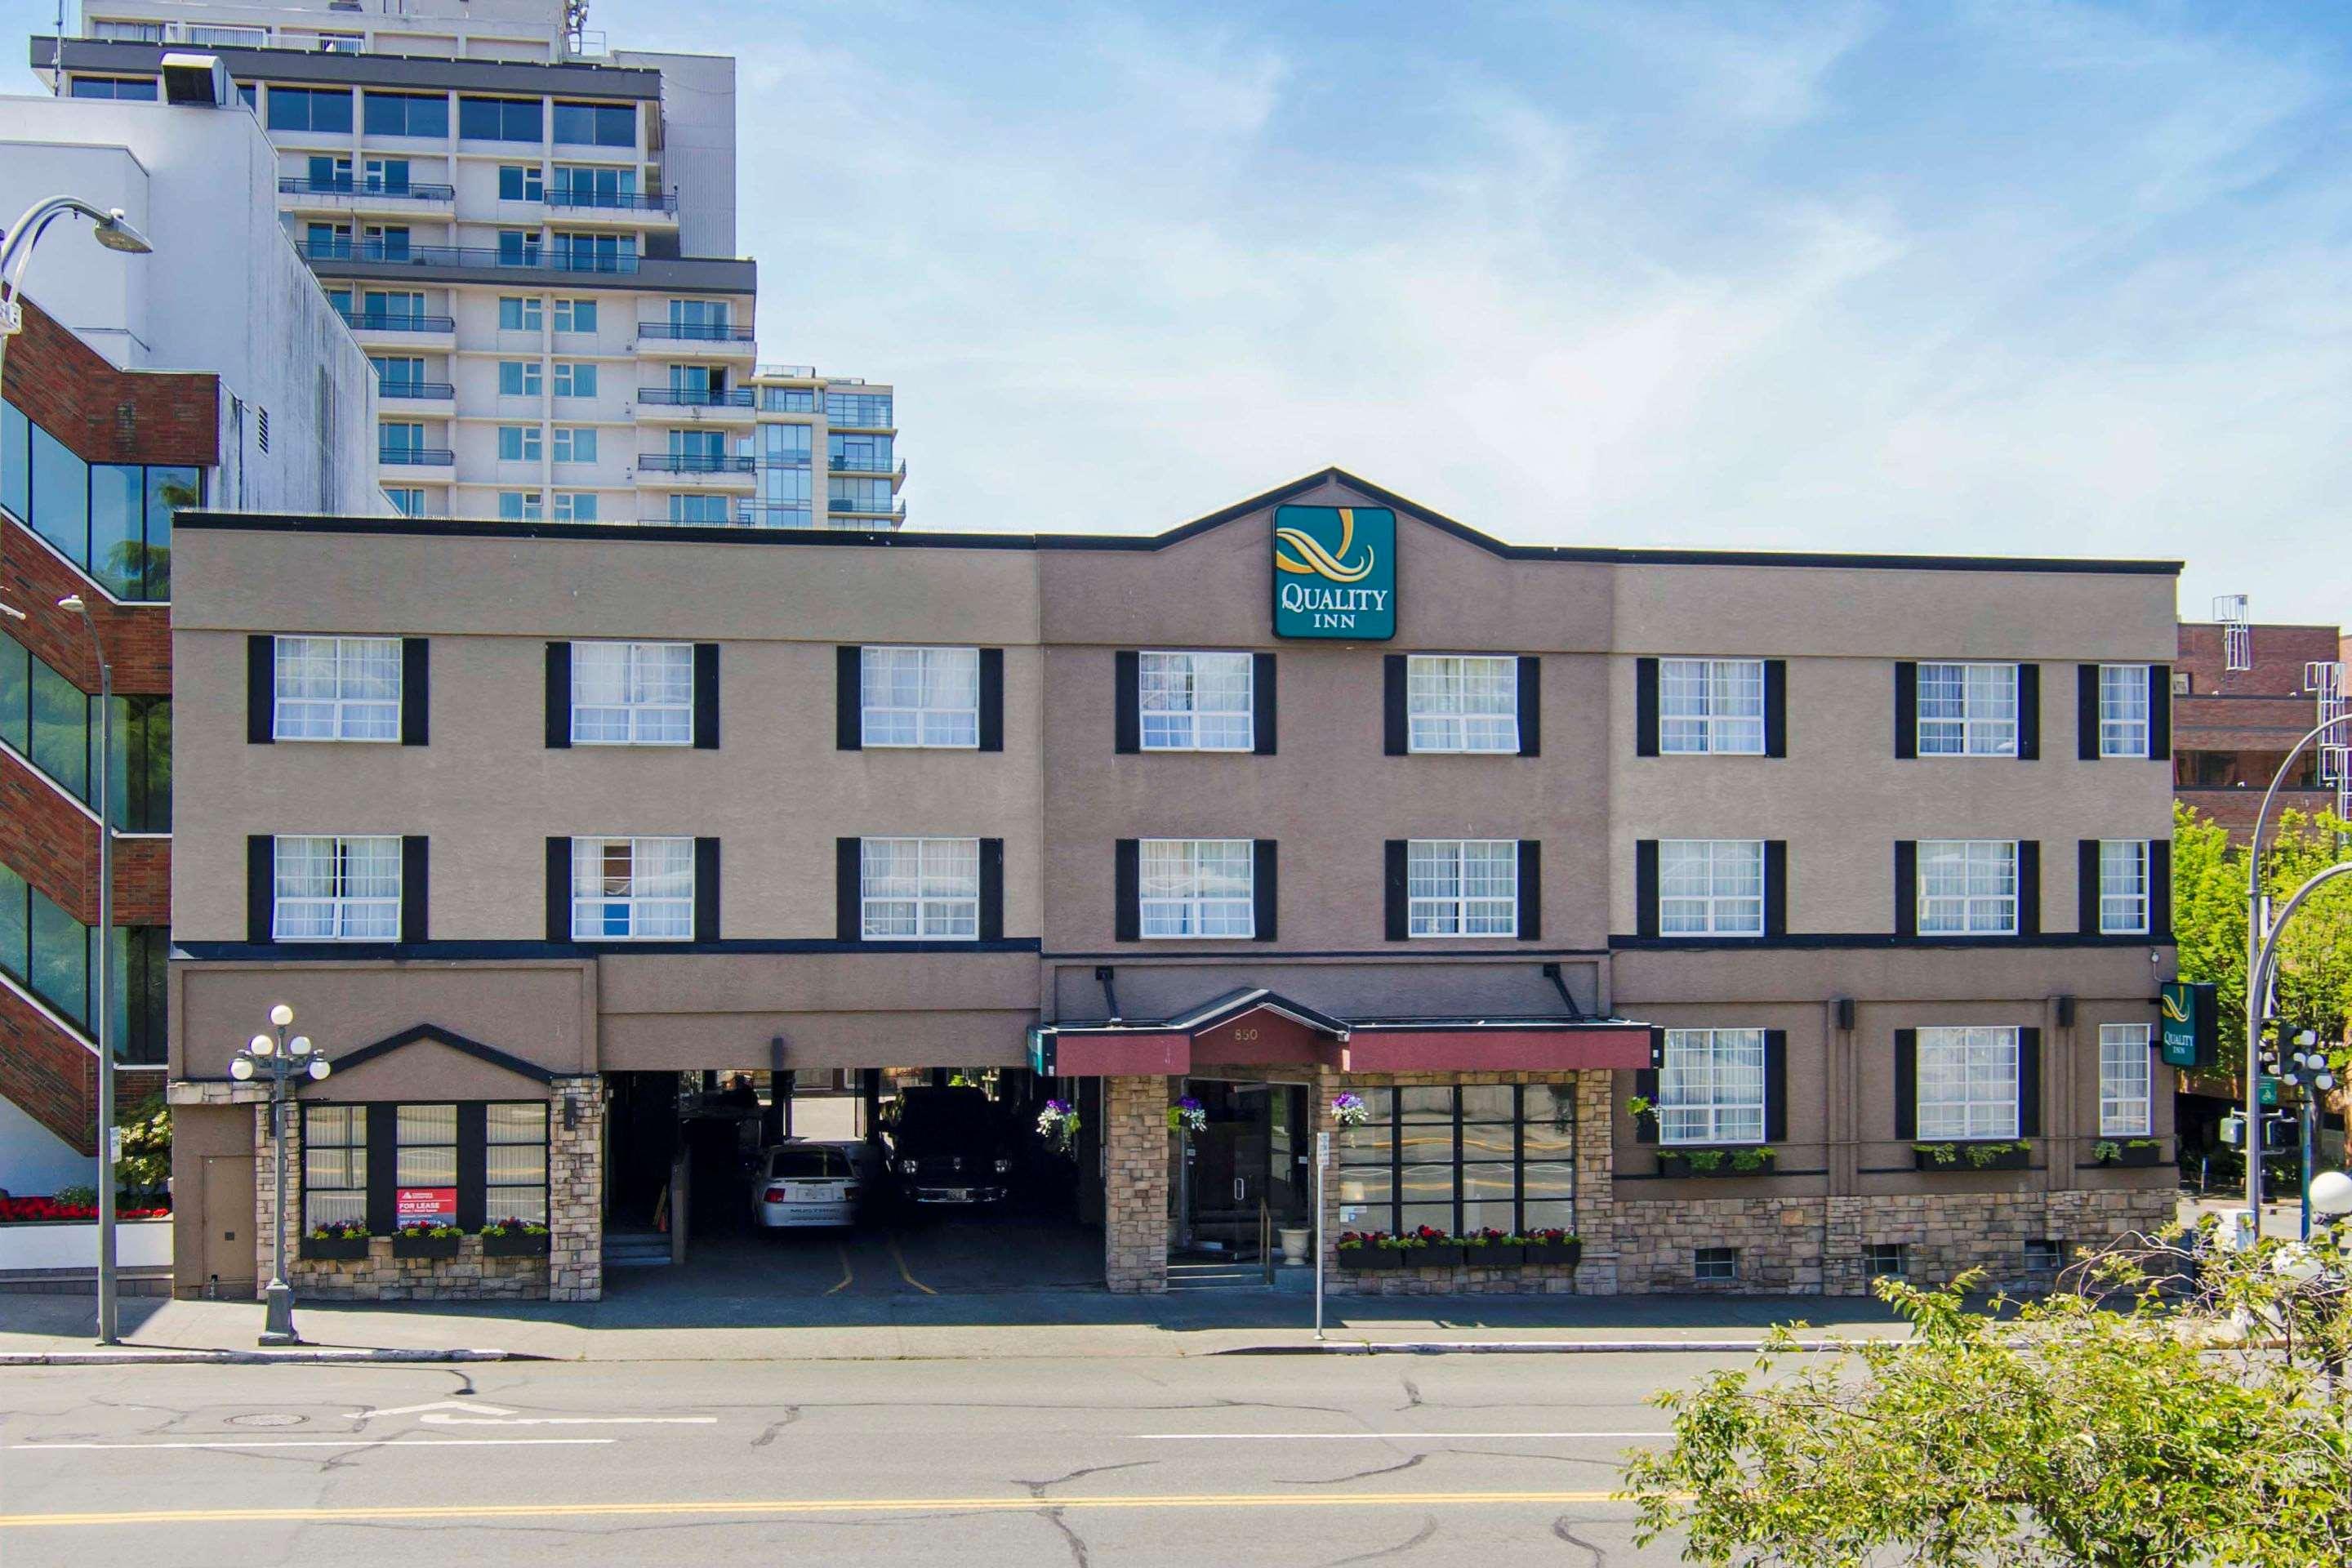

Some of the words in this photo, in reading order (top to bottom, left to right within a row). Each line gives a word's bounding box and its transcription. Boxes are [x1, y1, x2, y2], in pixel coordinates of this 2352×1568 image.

[1281, 582, 1388, 613] QUALITY
[1313, 613, 1356, 629] INN
[1235, 1029, 1258, 1040] 850
[2163, 1031, 2194, 1047] QUALITY
